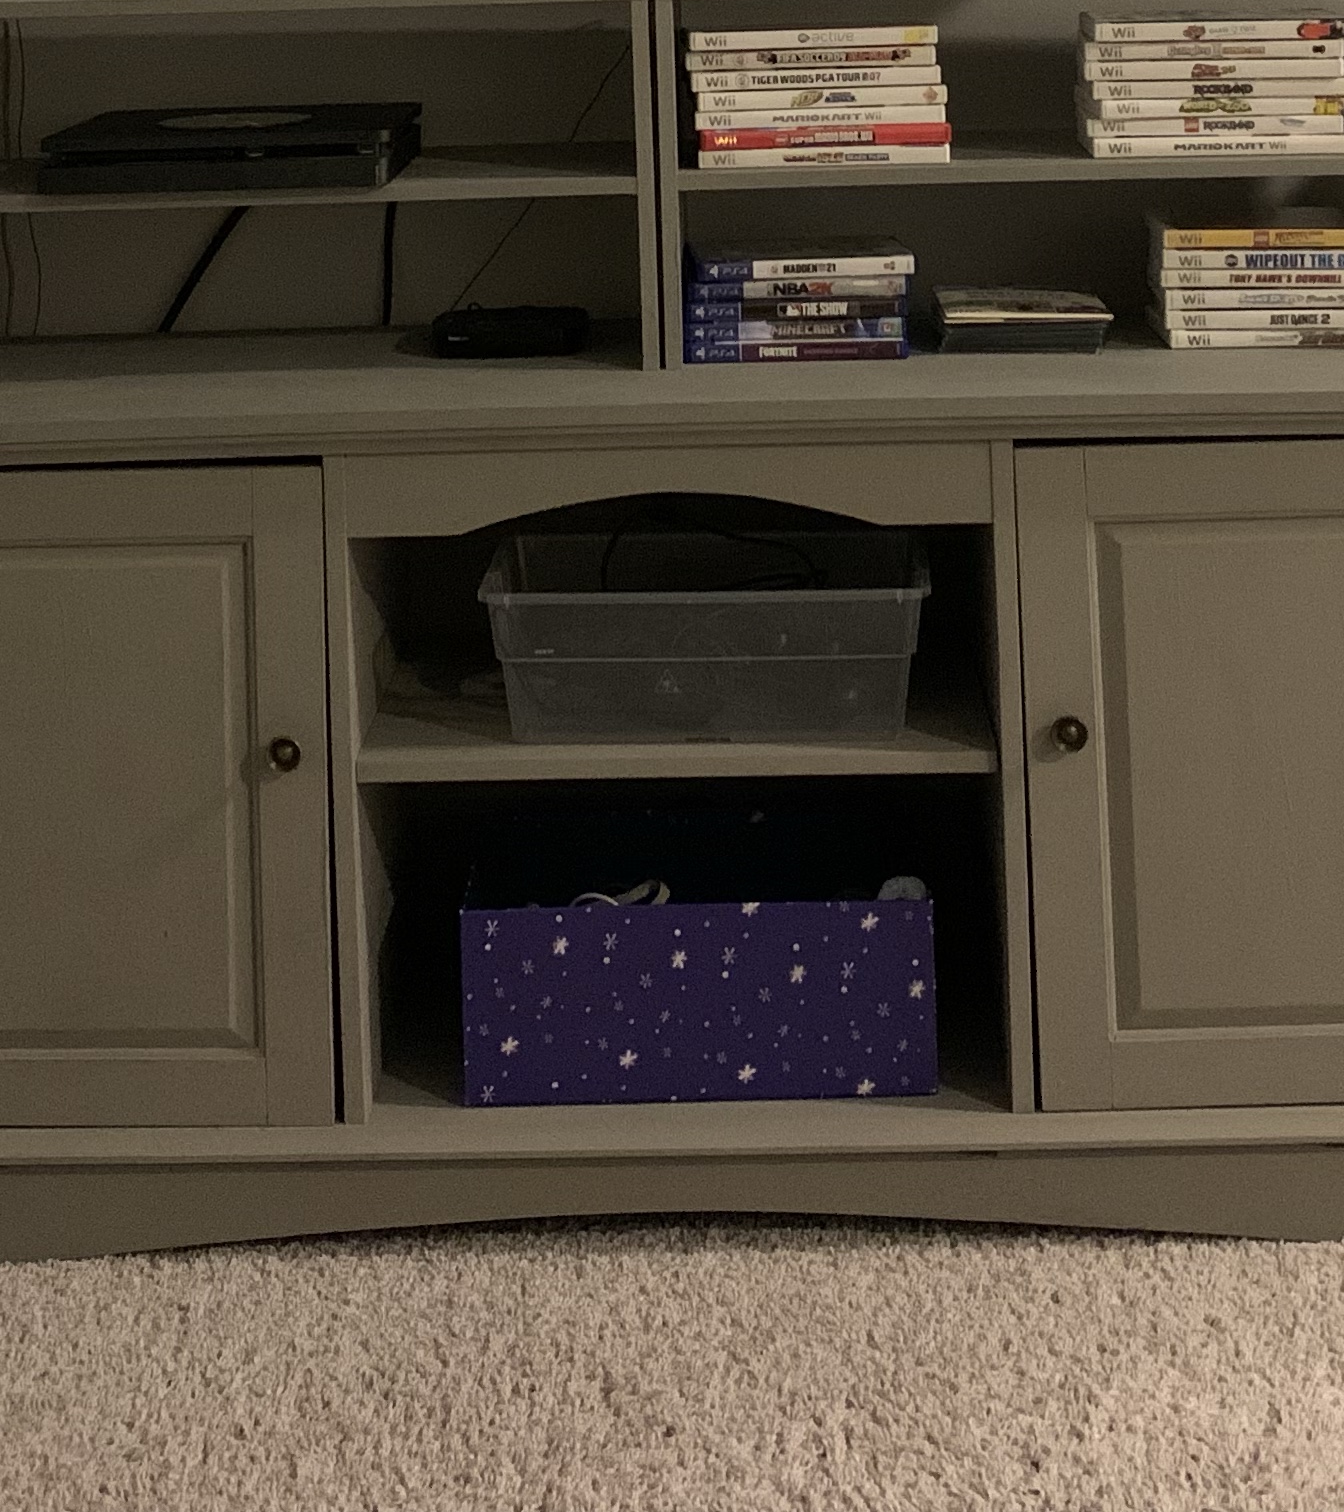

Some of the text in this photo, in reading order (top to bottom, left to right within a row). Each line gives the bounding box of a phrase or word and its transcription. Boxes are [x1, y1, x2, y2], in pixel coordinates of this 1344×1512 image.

[704, 31, 855, 48] Wii active
[1112, 27, 1136, 39] Wii
[1099, 46, 1123, 59] Wii
[700, 54, 724, 67] Wii
[1100, 66, 1123, 78] Wii
[706, 75, 729, 88] Wii
[751, 75, 779, 85] TIGER
[780, 74, 814, 84] WOODS
[815, 73, 835, 83] PGA
[836, 72, 861, 82] TOUR
[1108, 85, 1132, 97] Wii
[713, 94, 736, 107] Wii
[1117, 102, 1140, 114] Wii
[709, 114, 732, 127] Wii
[864, 111, 882, 121] Wii
[1102, 121, 1125, 133] Wii
[714, 135, 738, 147] Wii
[1108, 142, 1132, 155] Wii
[1268, 140, 1287, 150] Wii
[713, 153, 736, 166] Wii
[1179, 233, 1203, 245] Wii
[1178, 255, 1202, 267] Wii
[1244, 253, 1306, 269] WIPEOUT
[1309, 253, 1334, 268] THE
[722, 262, 837, 276] PS4 MADDEN 21
[1177, 272, 1202, 284] Wii
[1228, 273, 1252, 285] TONY
[1255, 273, 1292, 284] HAWK'S
[1295, 273, 1342, 284] DOWNHILL
[1182, 293, 1206, 306] Wii
[708, 301, 849, 317] PS4 THE SHOW
[1182, 313, 1331, 327] Wii JUST DANCE 2
[708, 323, 846, 338] PS4 MINECRAFT
[1187, 334, 1211, 347] Wii
[708, 348, 735, 358] PS4
[758, 346, 798, 358] FORTNITE
